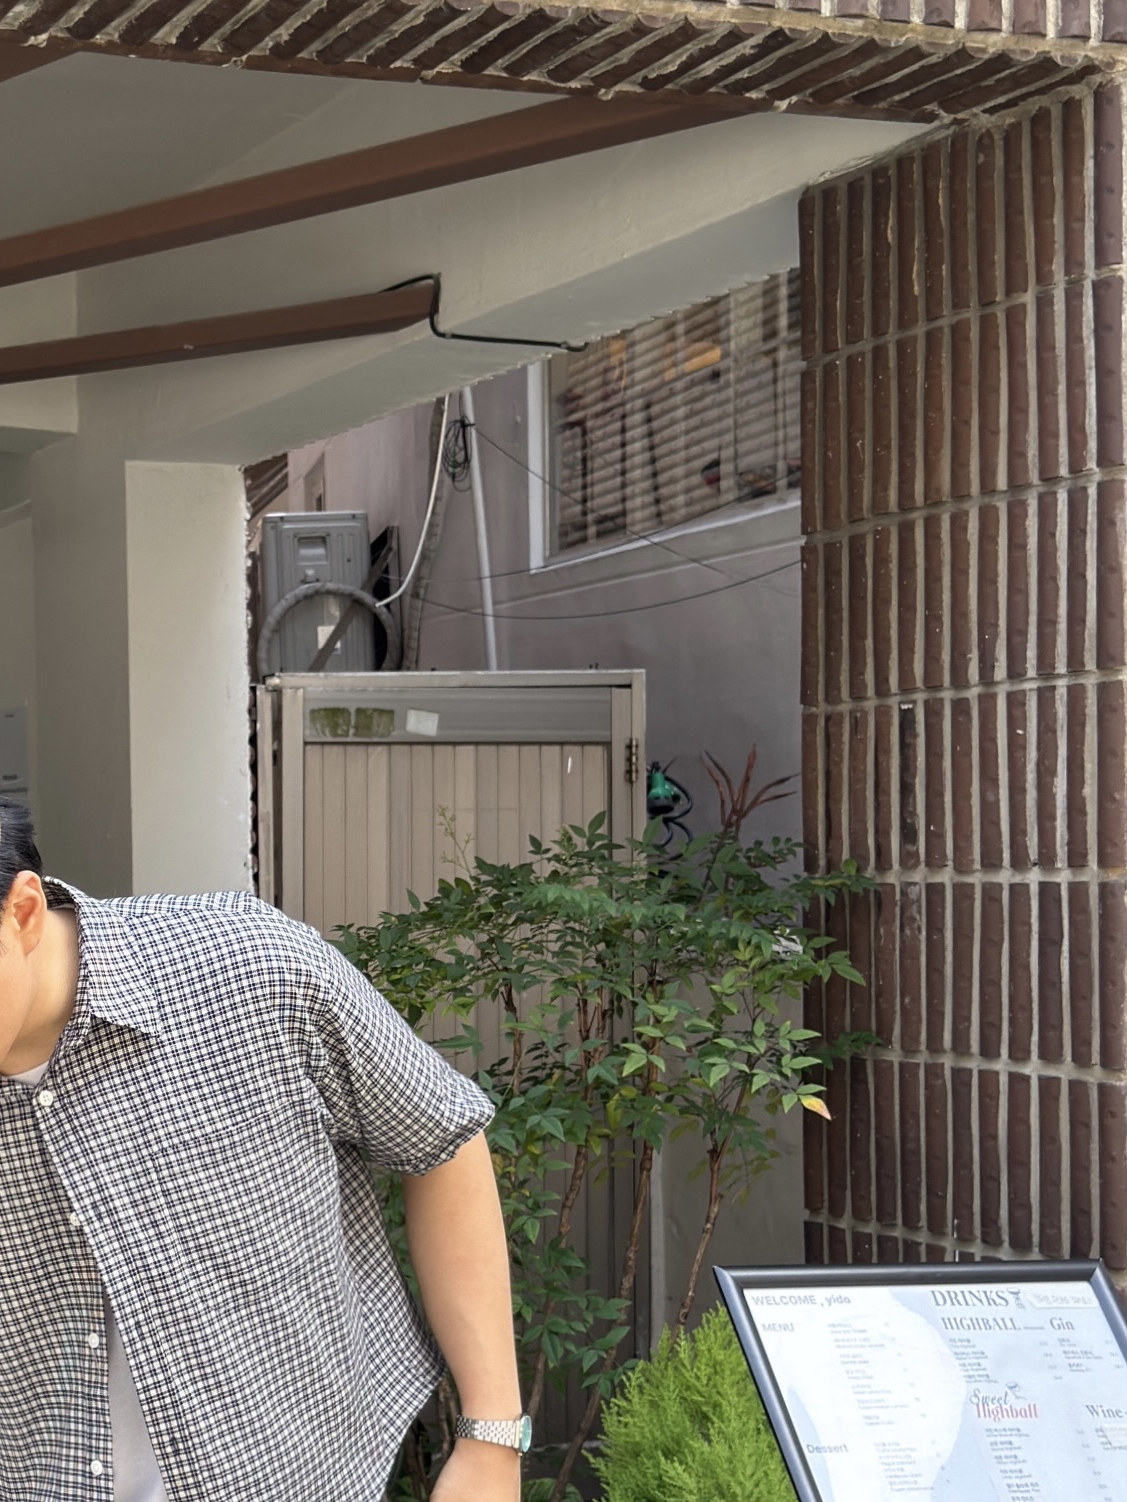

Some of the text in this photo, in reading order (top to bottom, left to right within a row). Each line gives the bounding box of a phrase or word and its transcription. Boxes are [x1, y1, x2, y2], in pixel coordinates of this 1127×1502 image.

[931, 1289, 1009, 1307] DRINKS
[762, 1323, 794, 1333] MENU
[941, 1316, 1021, 1331] HIGHBALL
[1049, 1316, 1075, 1331] Gin
[969, 1388, 1010, 1406] Sweet
[974, 1403, 1039, 1423] Highball
[1085, 1404, 1123, 1418] Wine
[806, 1444, 849, 1454] Dessert
